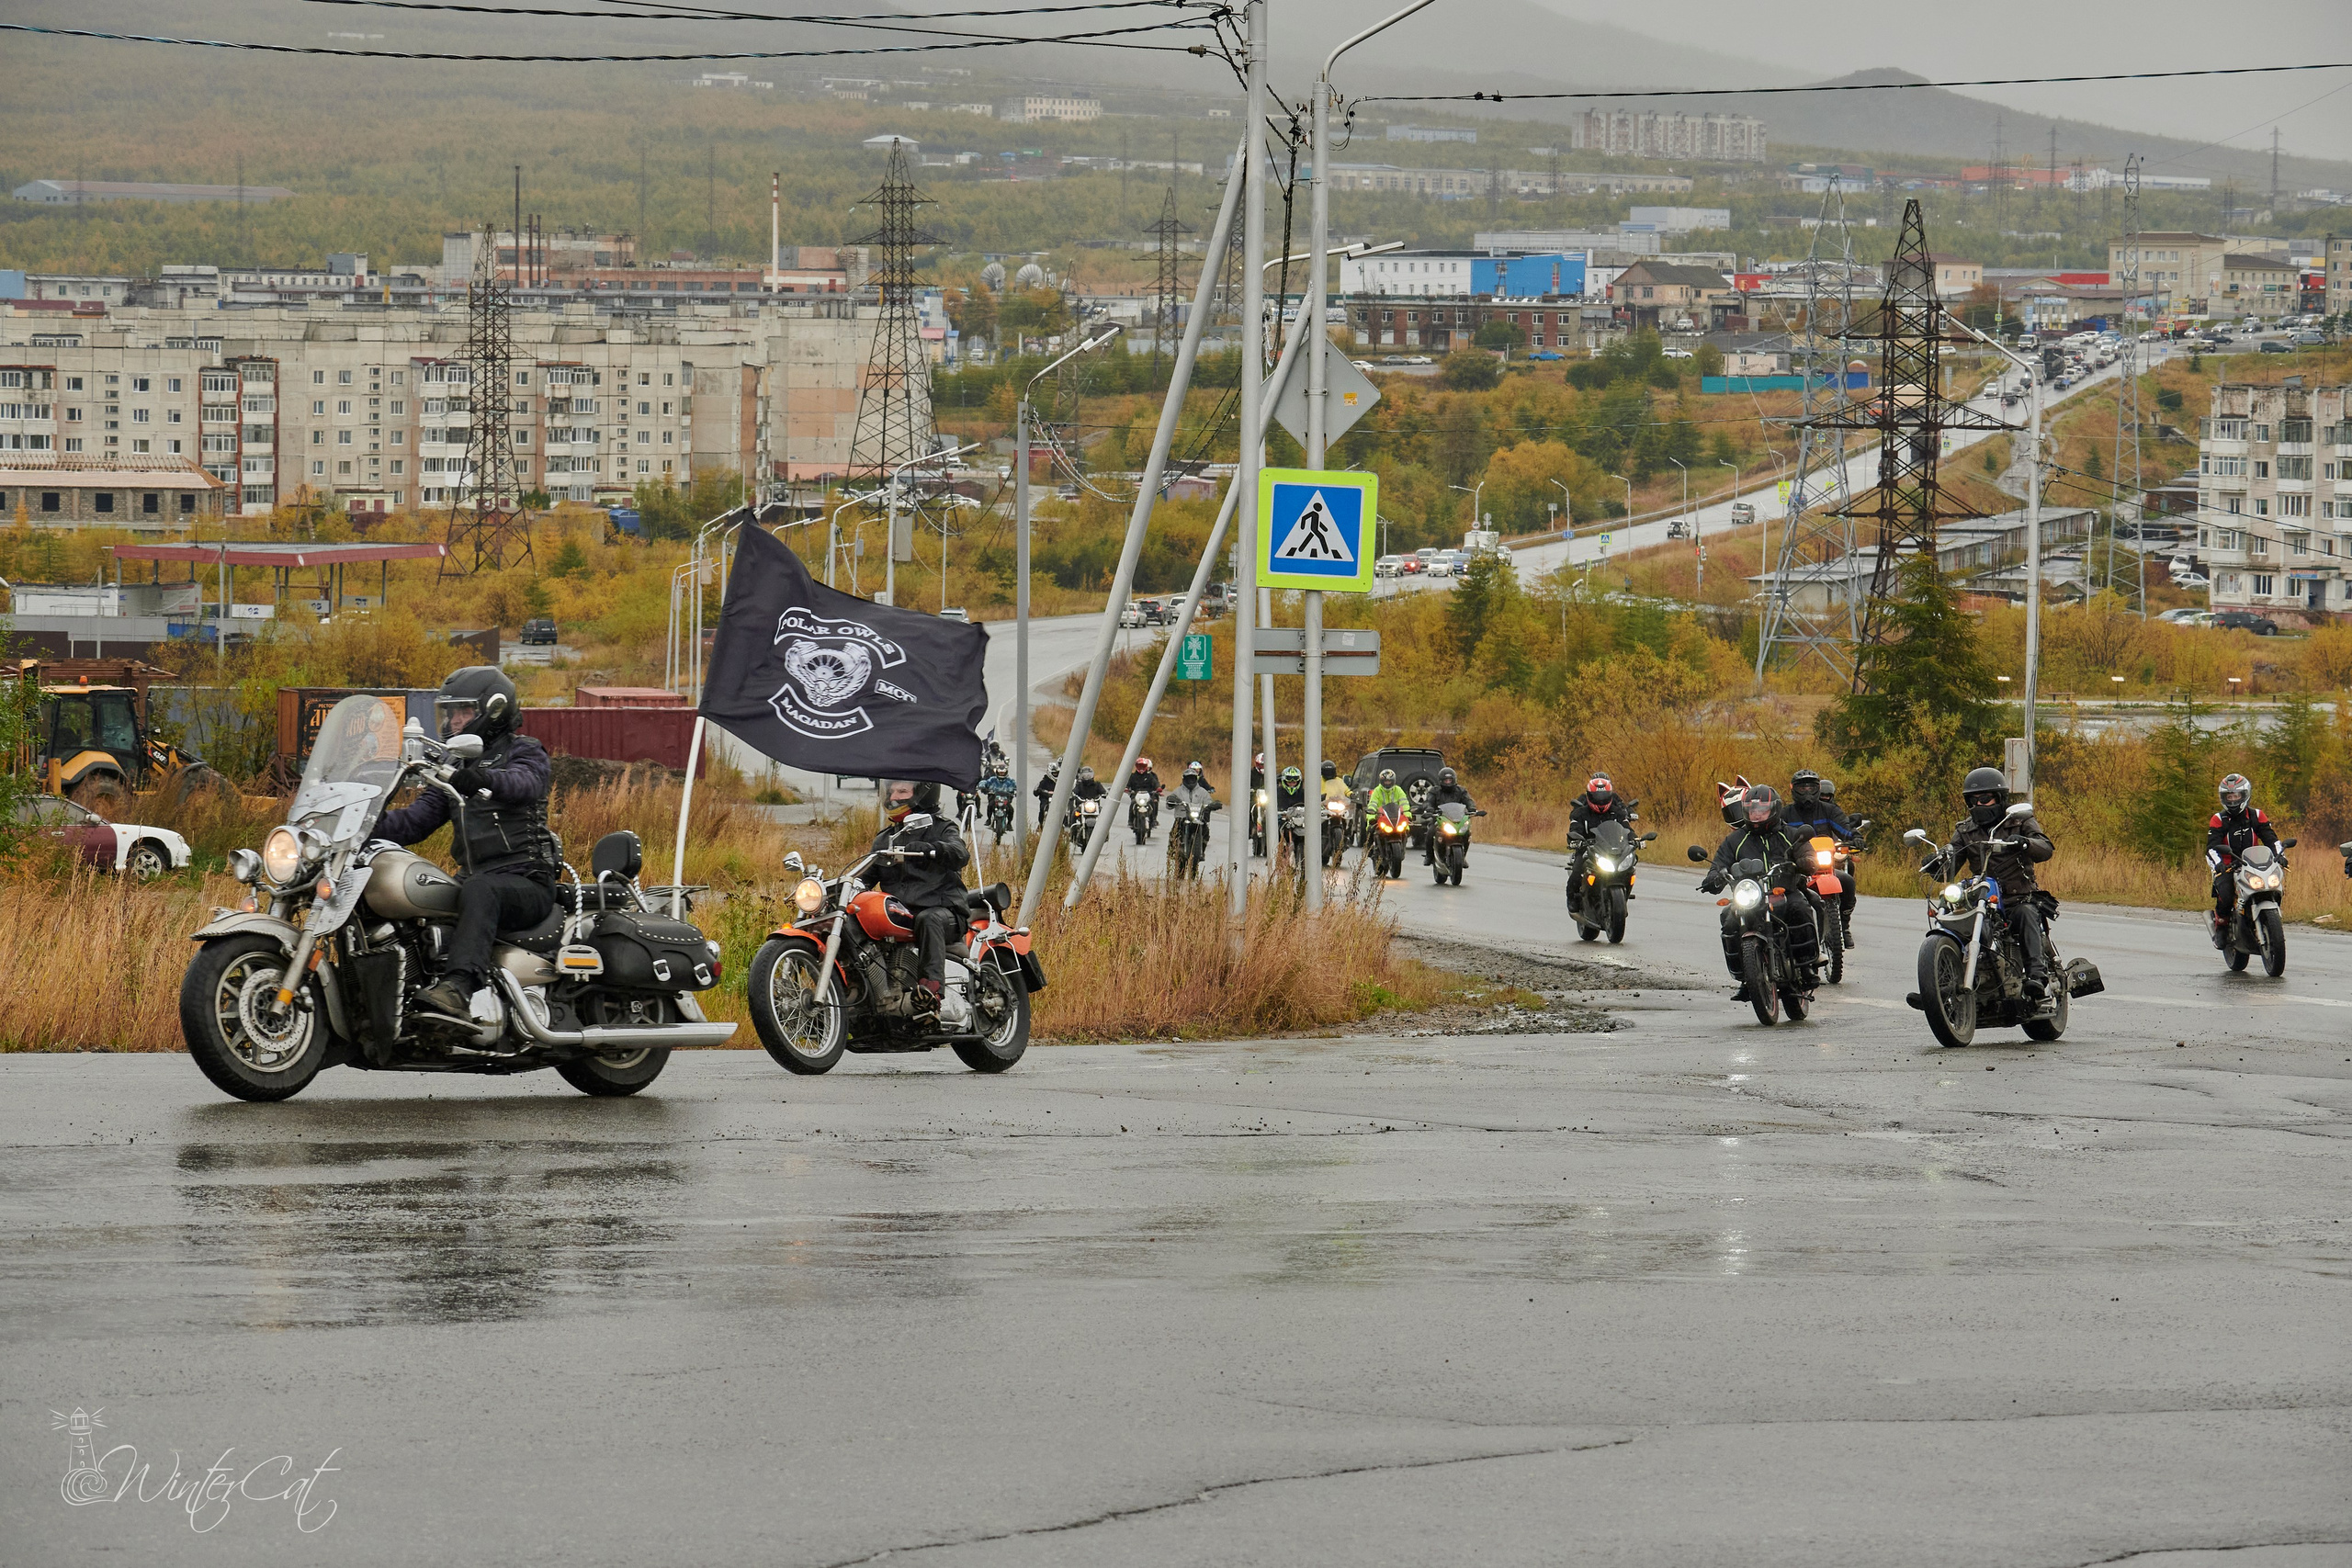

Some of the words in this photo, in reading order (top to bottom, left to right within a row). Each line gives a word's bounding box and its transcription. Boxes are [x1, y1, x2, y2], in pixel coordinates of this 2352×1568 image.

[247, 607, 259, 615] 92
[781, 616, 831, 636] POLAR
[837, 625, 896, 656] OWLS
[780, 697, 858, 730] MAGADAN
